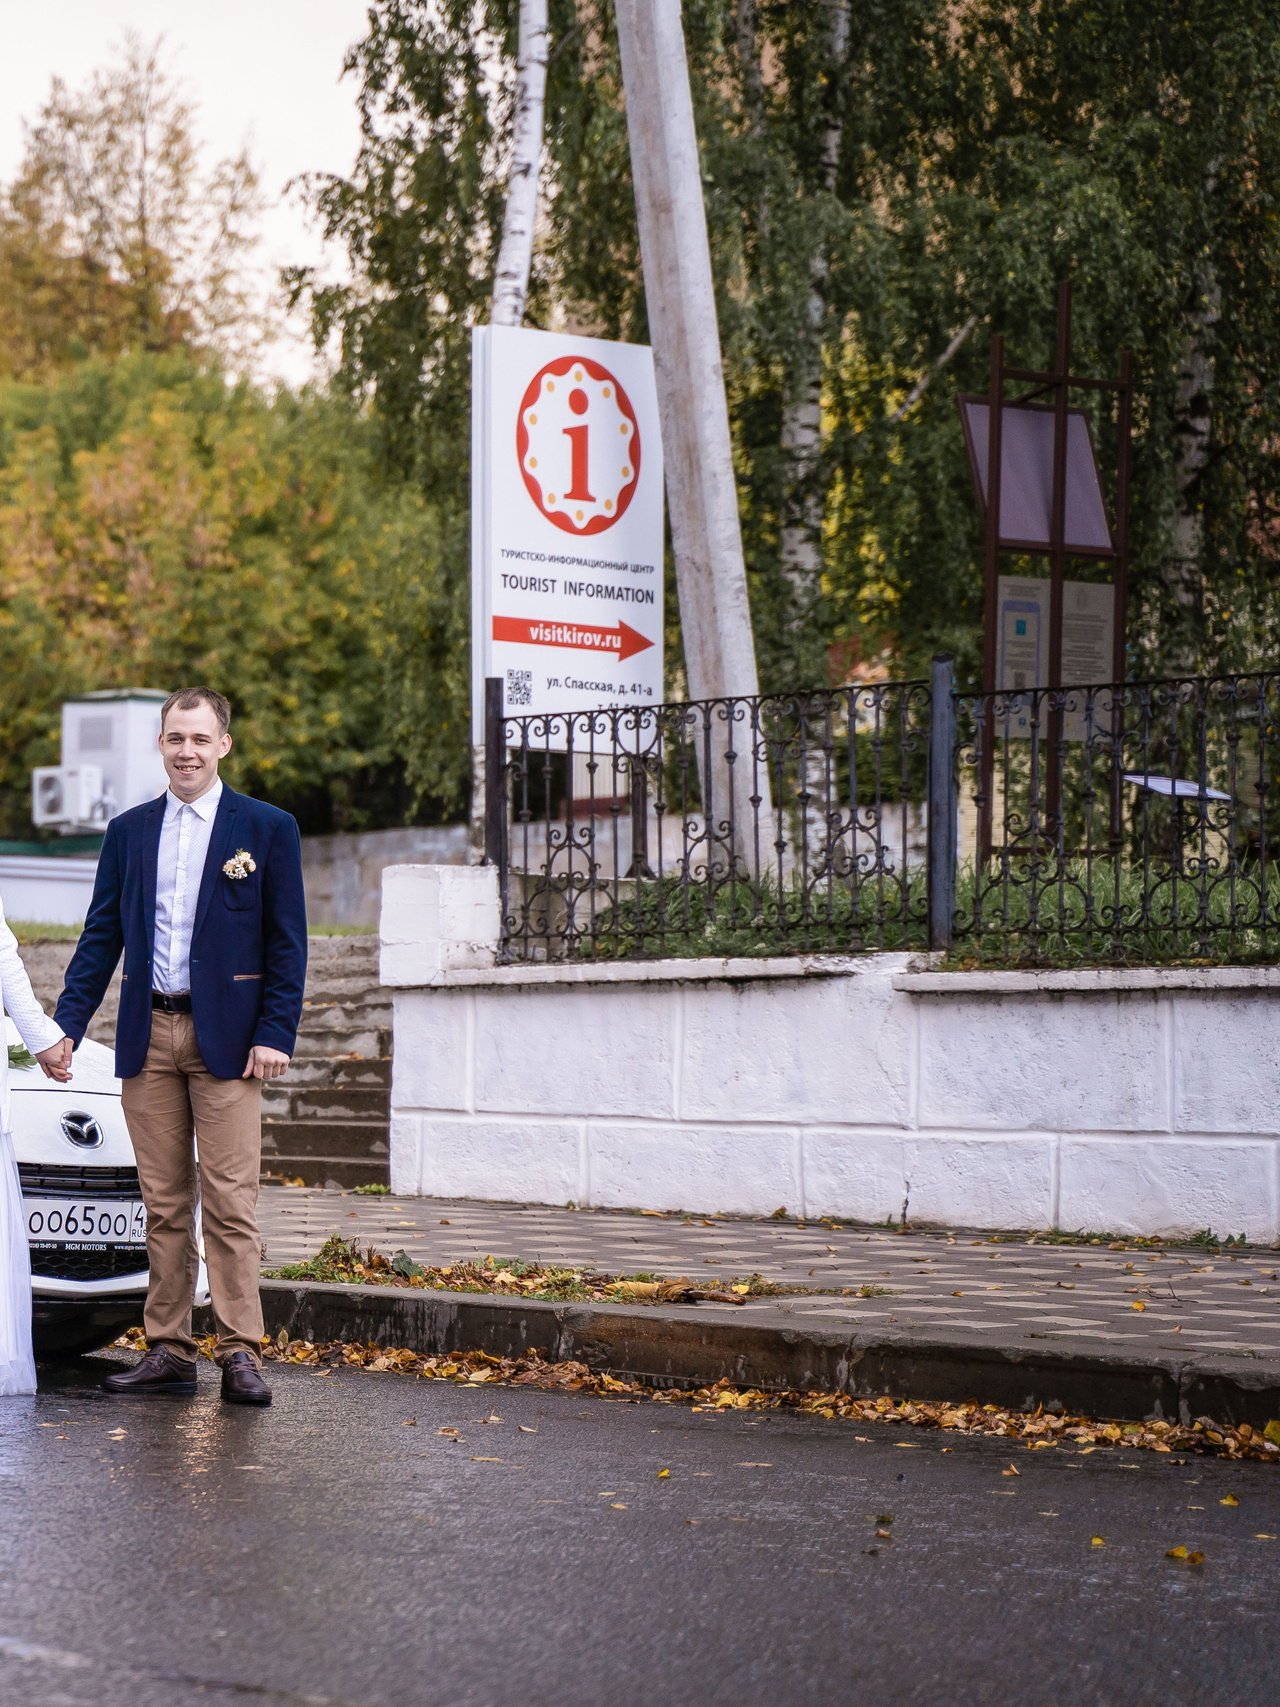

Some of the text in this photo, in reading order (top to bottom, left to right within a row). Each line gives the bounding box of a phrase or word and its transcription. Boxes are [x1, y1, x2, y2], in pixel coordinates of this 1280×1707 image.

[501, 549, 654, 574] ТУРИСТСКО-ИНФОРМАЦИОННЫЙ ЦЕНТР
[501, 574, 654, 604] TOURIST INFORMATION
[529, 623, 622, 648] visitkirov.ru
[546, 676, 653, 696] ул. Спасская, д. 41-а
[131, 1228, 147, 1238] RUS
[65, 1243, 81, 1251] MGM
[81, 1243, 108, 1251] MOTORS
